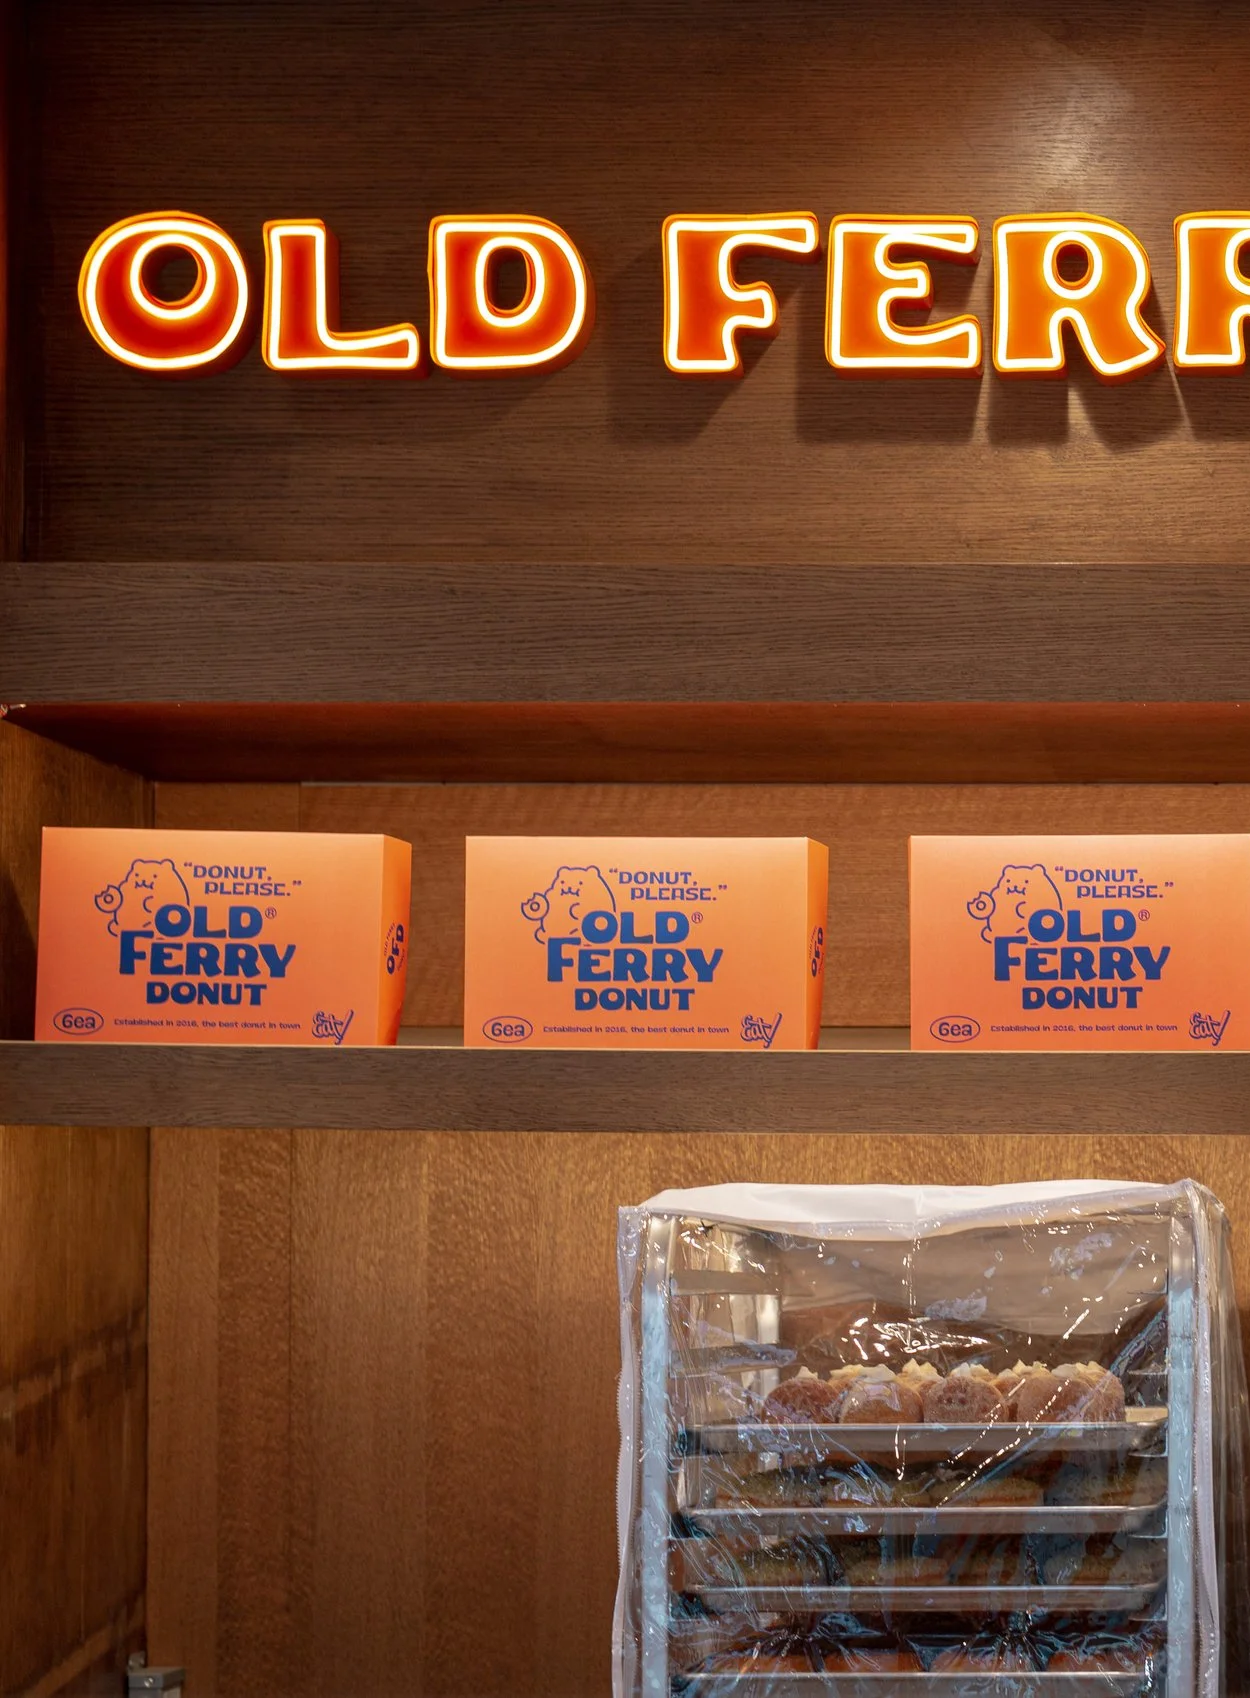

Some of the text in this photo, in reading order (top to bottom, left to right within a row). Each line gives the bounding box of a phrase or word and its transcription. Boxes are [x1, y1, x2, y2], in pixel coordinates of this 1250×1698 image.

[78, 210, 592, 376] OLD
[119, 930, 296, 979] FERRY
[547, 937, 723, 983] FERRY
[994, 935, 1171, 981] FERRY
[146, 981, 266, 1006] DONUT
[575, 988, 694, 1011] DONUT
[1022, 986, 1142, 1009] DONUT
[63, 1014, 96, 1029] 6ea
[114, 1019, 164, 1027] Established
[202, 1020, 217, 1028] the
[492, 1022, 525, 1037] 6ea
[939, 1021, 973, 1036] 6ea
[1118, 1024, 1143, 1032] donut
